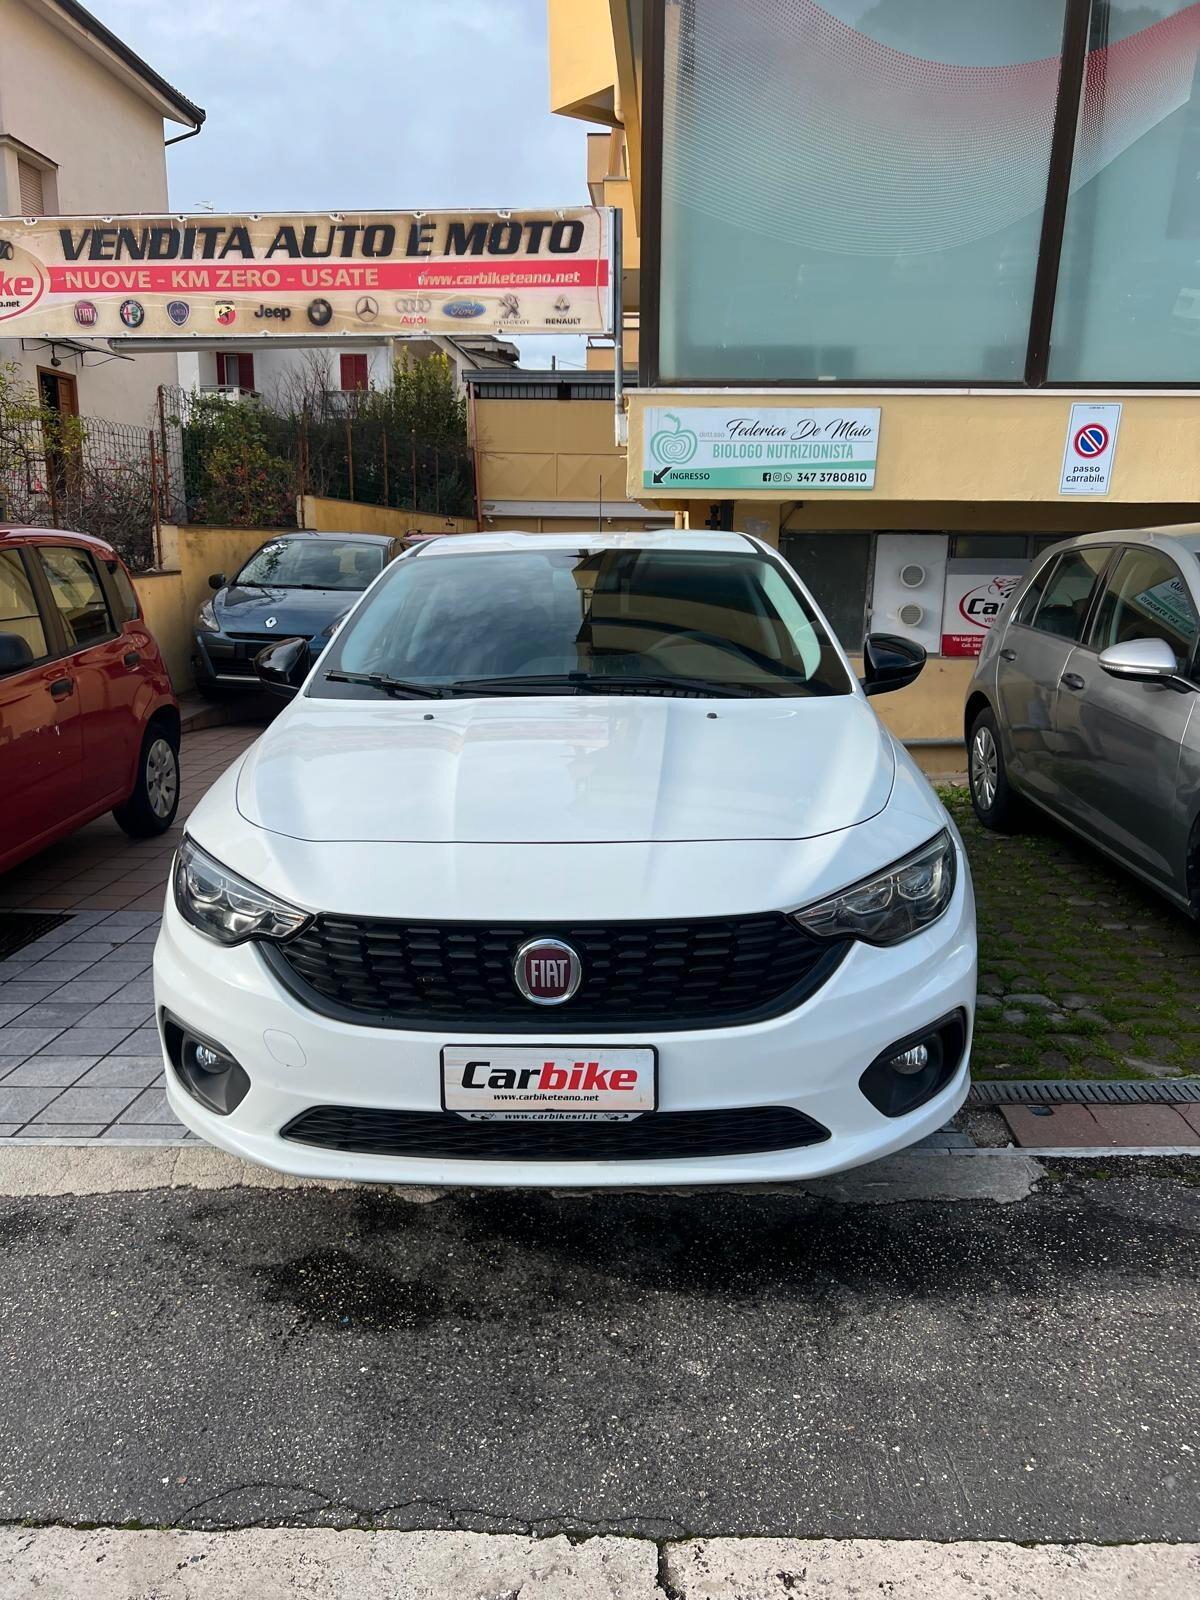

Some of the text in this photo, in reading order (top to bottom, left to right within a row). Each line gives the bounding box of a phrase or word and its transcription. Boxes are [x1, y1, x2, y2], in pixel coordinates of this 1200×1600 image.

[60, 220, 585, 260] VENDITA AUTO E MOTO
[65, 270, 151, 289] NUOVE
[171, 270, 211, 288] KM
[215, 269, 280, 288] ZERO
[301, 268, 379, 287] USATE
[418, 271, 580, 287] www.carbiketeano.net
[78, 308, 93, 321] FIAT
[254, 304, 291, 321] Jeep
[450, 304, 477, 317] Ford
[400, 315, 428, 325] Audi
[726, 418, 787, 440] Federica
[790, 418, 821, 440] De
[825, 418, 872, 440] Maio
[713, 444, 853, 459] BIOLOGO NUTRIZIONISTA
[670, 472, 710, 480] INGRESSO
[796, 473, 867, 483] 347 3780810
[1066, 474, 1105, 483] carrabile
[530, 959, 569, 988] FIAT
[461, 1061, 639, 1091] Carbike
[493, 1092, 600, 1102] www.carbiketeano.net
[505, 1112, 598, 1121] www.carbikesrl.it
